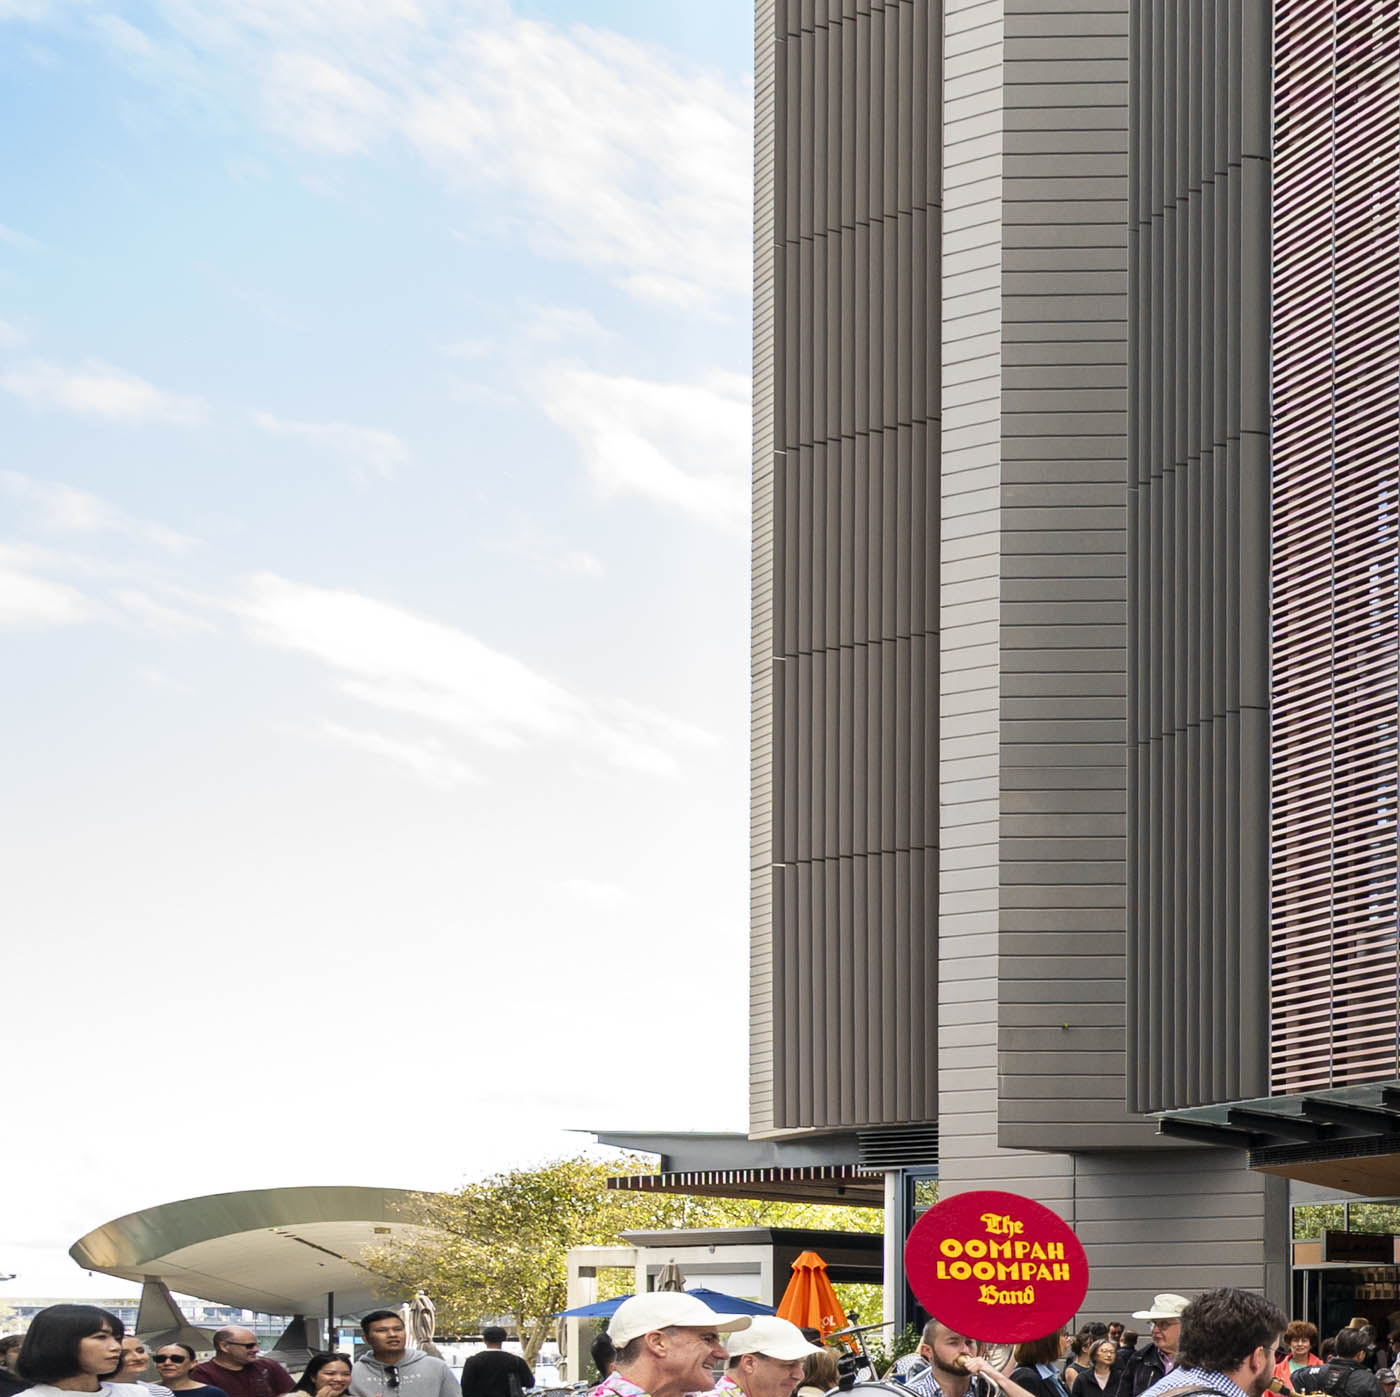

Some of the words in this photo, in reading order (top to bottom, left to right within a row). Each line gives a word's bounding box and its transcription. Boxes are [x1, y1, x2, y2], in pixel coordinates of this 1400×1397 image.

[980, 1213, 1024, 1238] The
[939, 1238, 1064, 1260] OOMPAH
[936, 1261, 1070, 1281] LOOMPAH
[977, 1284, 1035, 1306] Band
